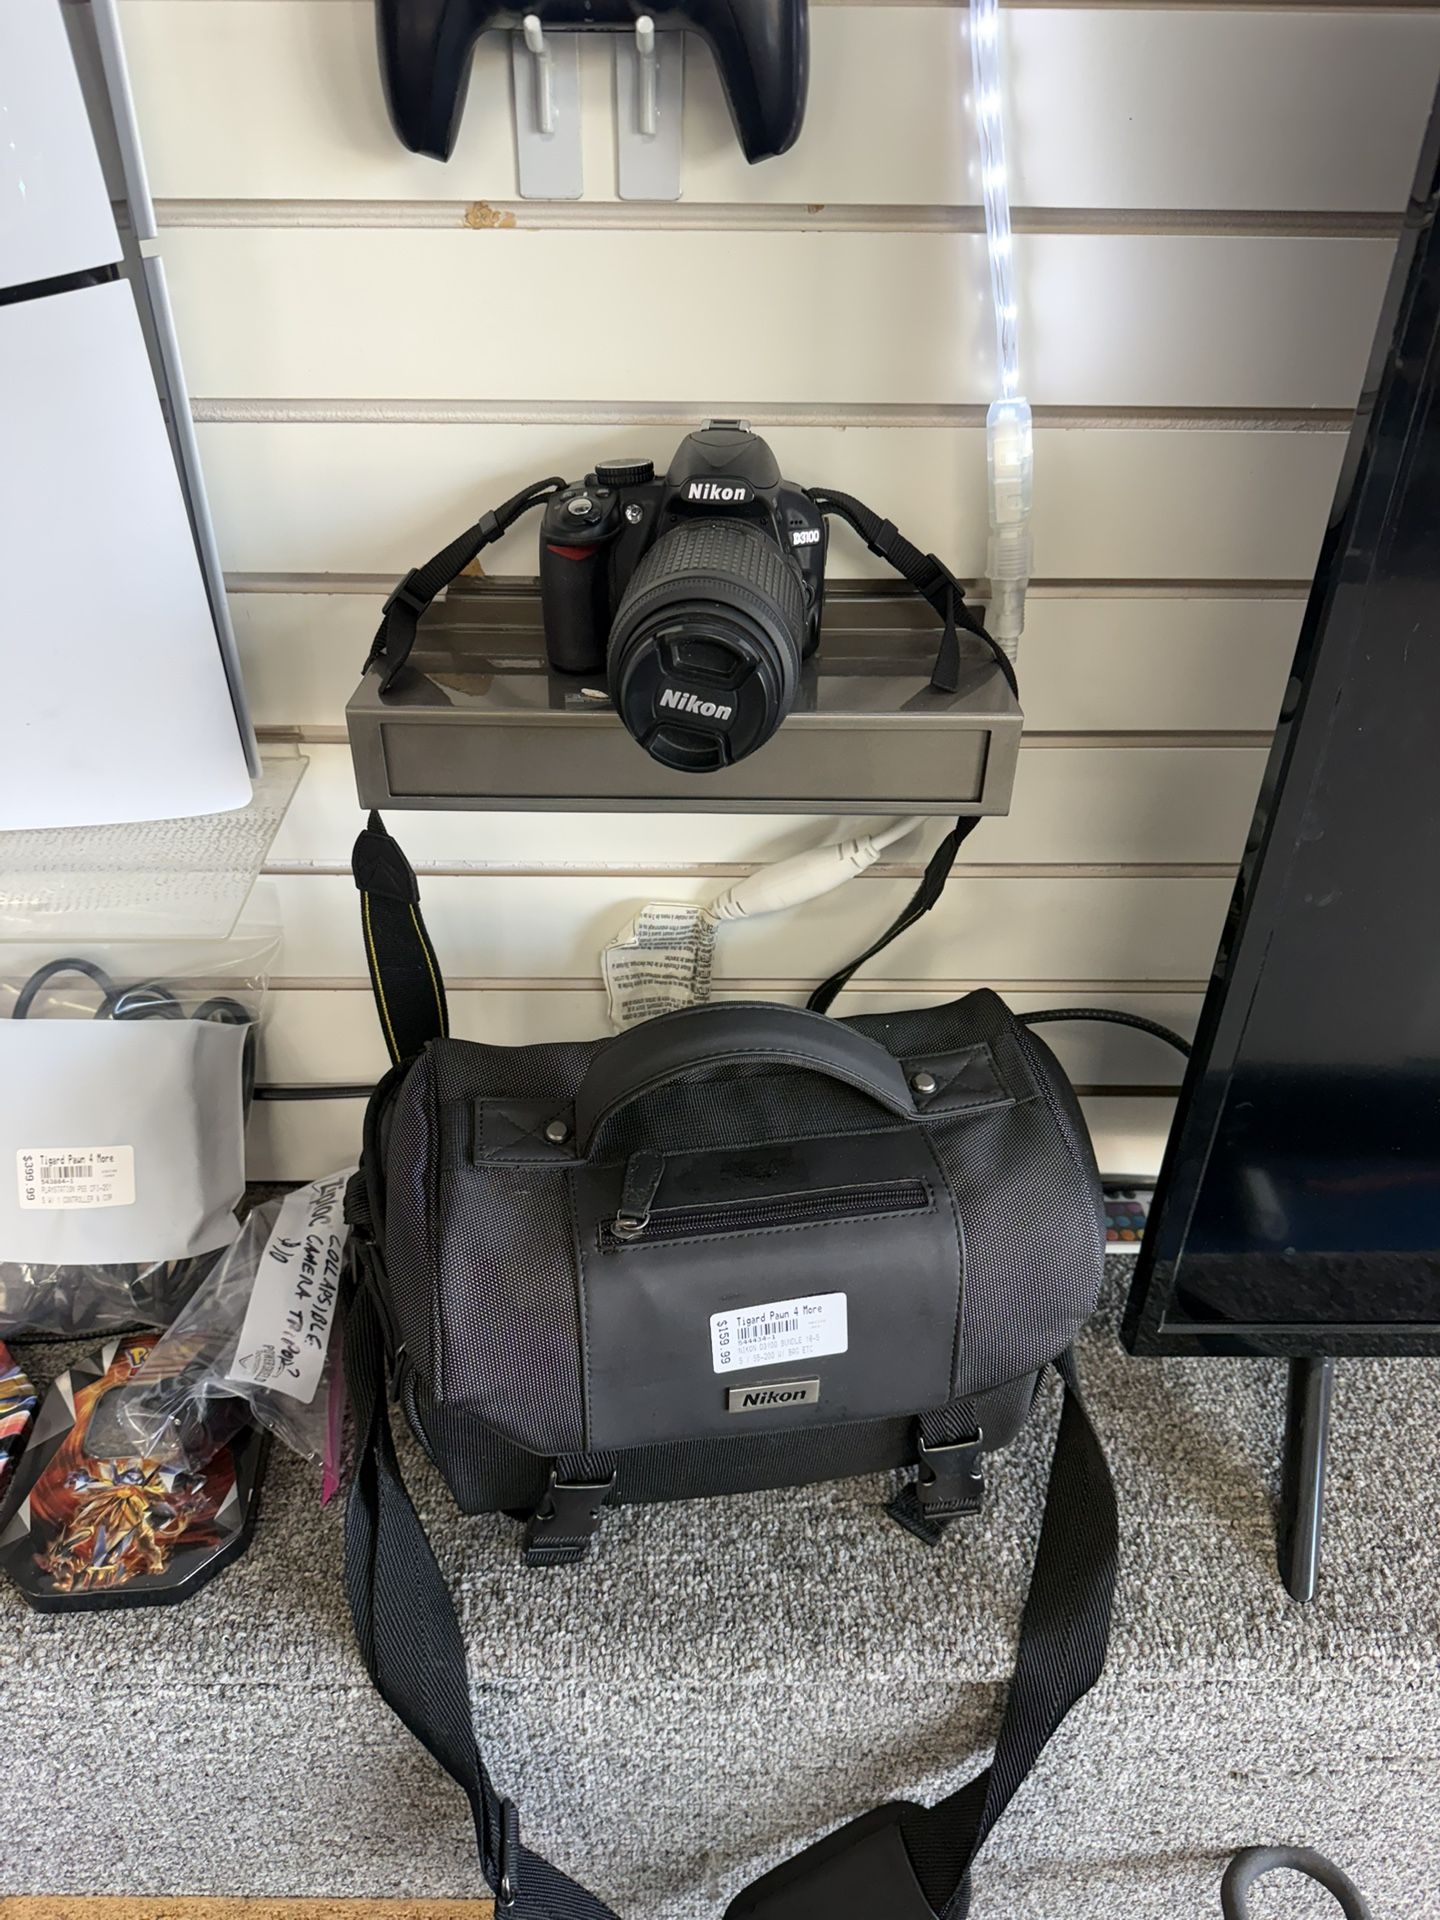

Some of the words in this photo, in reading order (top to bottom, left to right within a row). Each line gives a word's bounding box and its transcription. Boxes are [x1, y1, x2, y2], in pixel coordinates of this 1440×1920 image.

[688, 482, 746, 501] Nikon
[792, 529, 820, 546] D3100
[659, 689, 733, 721] Nikon
[40, 1154, 65, 1167] Tigard
[68, 1154, 85, 1165] Pawn
[97, 1153, 114, 1163] More
[22, 1155, 35, 1201] $399.99
[309, 1176, 345, 1228] Ziploc
[269, 1236, 302, 1264] $10
[295, 1234, 323, 1300] CAMERA
[304, 1235, 342, 1350] COLLAPSIBLE
[737, 1313, 766, 1327] Tigard
[769, 1310, 789, 1321] Pawn
[803, 1305, 823, 1315] More
[717, 1319, 731, 1365] $159.99
[742, 1389, 807, 1407] Nikon
